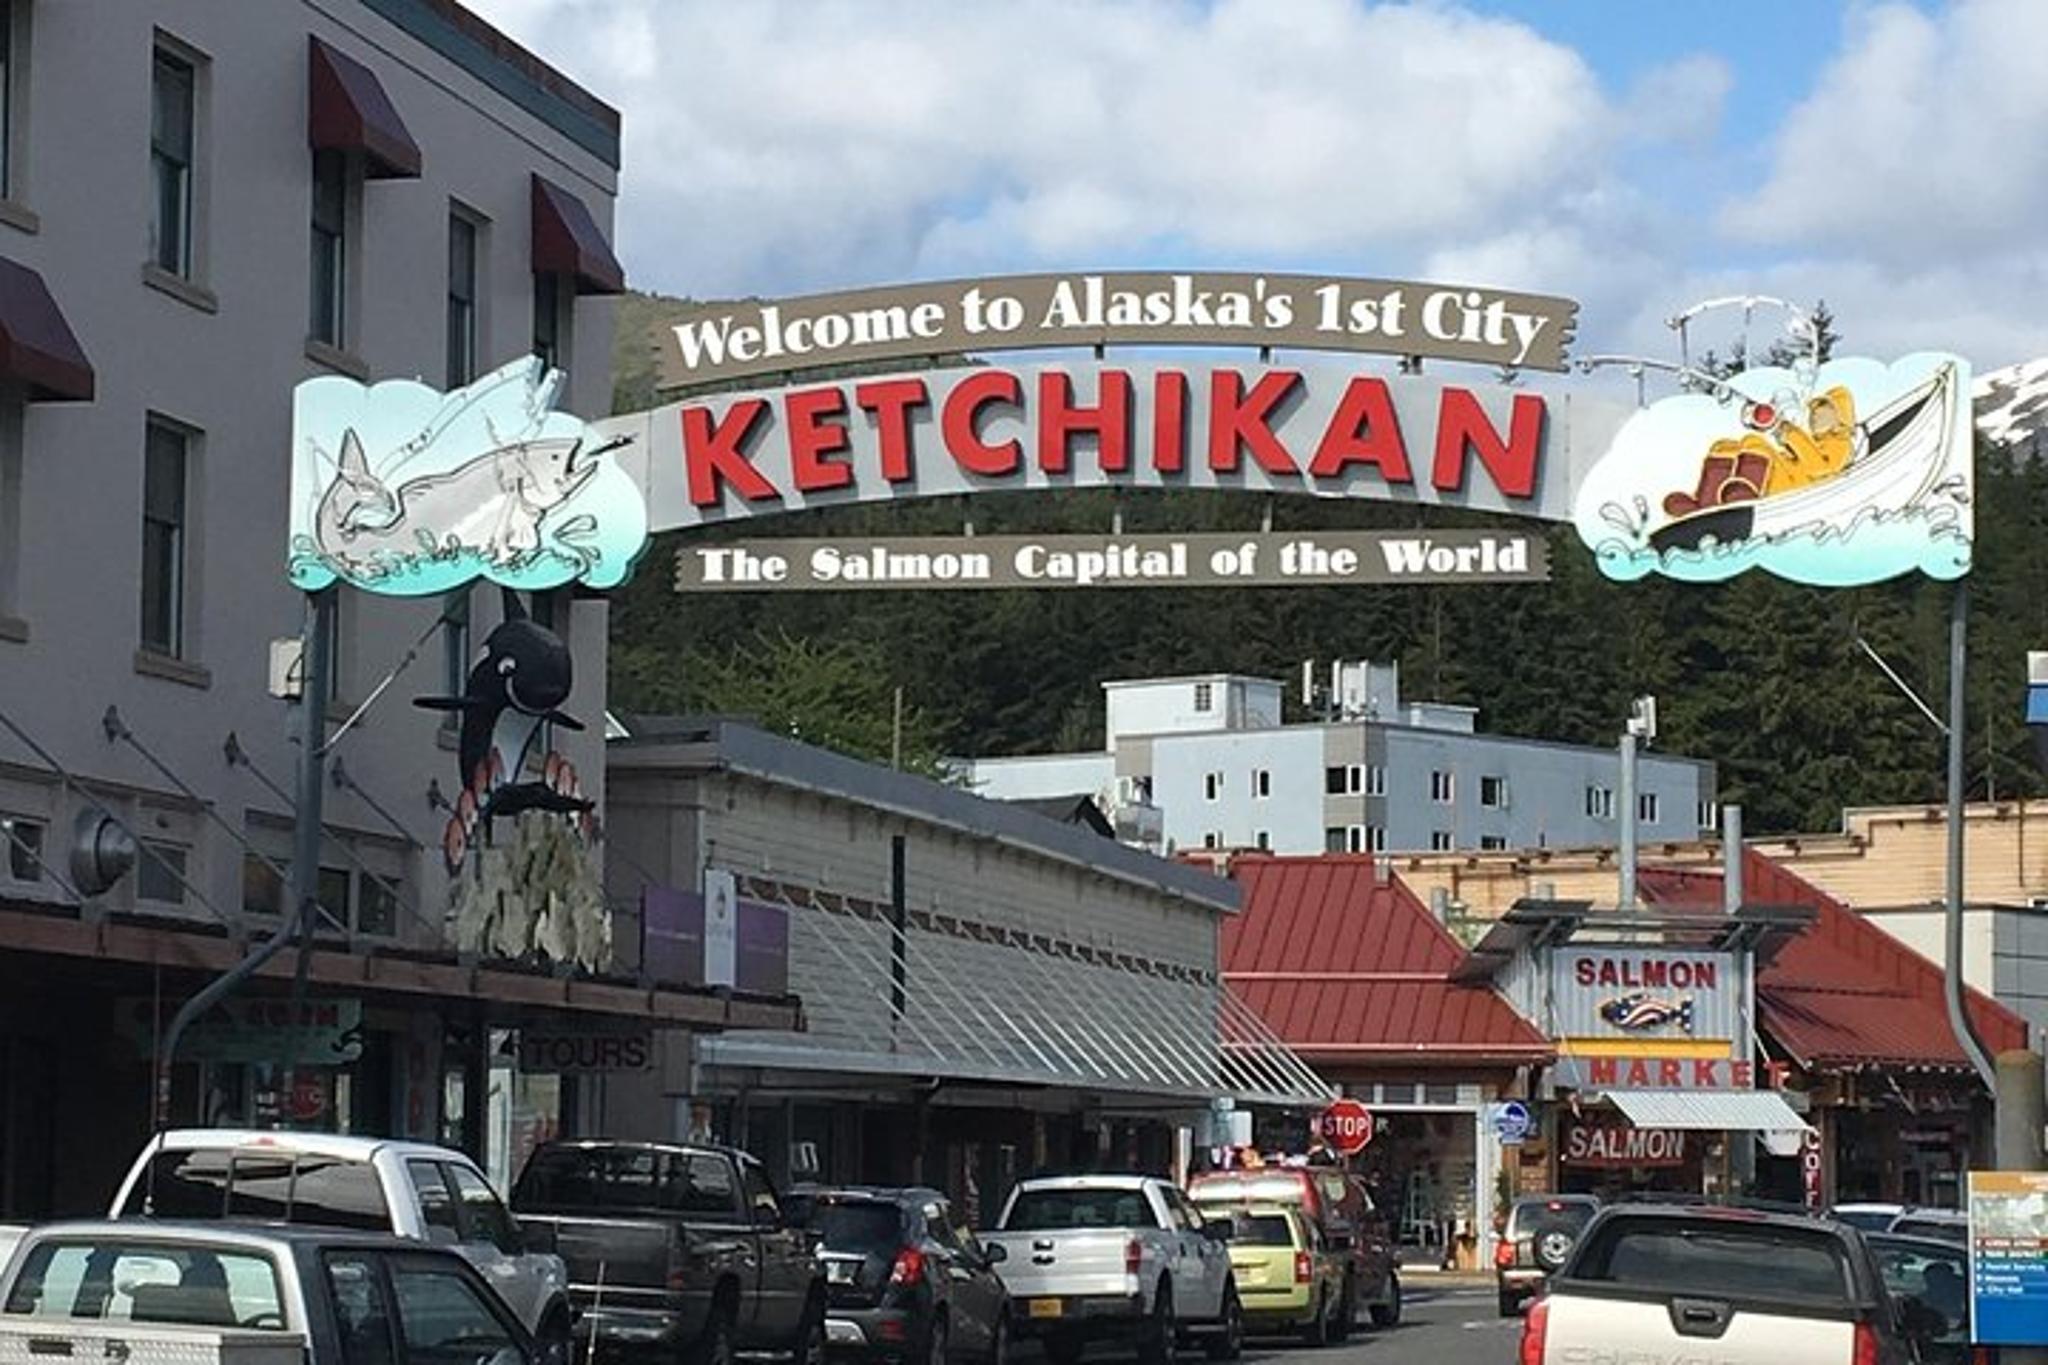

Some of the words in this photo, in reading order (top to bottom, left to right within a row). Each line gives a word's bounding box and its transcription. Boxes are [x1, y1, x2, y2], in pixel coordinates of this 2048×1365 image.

[672, 305, 945, 370] Welcome
[961, 288, 1025, 333] to
[1040, 275, 1293, 330] Alaska's
[1314, 284, 1405, 336] 1st
[1422, 291, 1548, 364] City
[681, 369, 1546, 507] KETCHIKAN
[696, 547, 788, 582] The
[810, 547, 992, 582] Salmon
[1014, 543, 1188, 584] Capital
[1210, 543, 1258, 577] of
[1279, 540, 1358, 576] the
[1378, 539, 1530, 575] World
[1575, 957, 1717, 989] SALMON
[526, 1036, 647, 1068] TOURS
[1590, 1058, 1789, 1090] MARKET
[1324, 1115, 1368, 1136] STOP
[1569, 1128, 1684, 1160] SALMON
